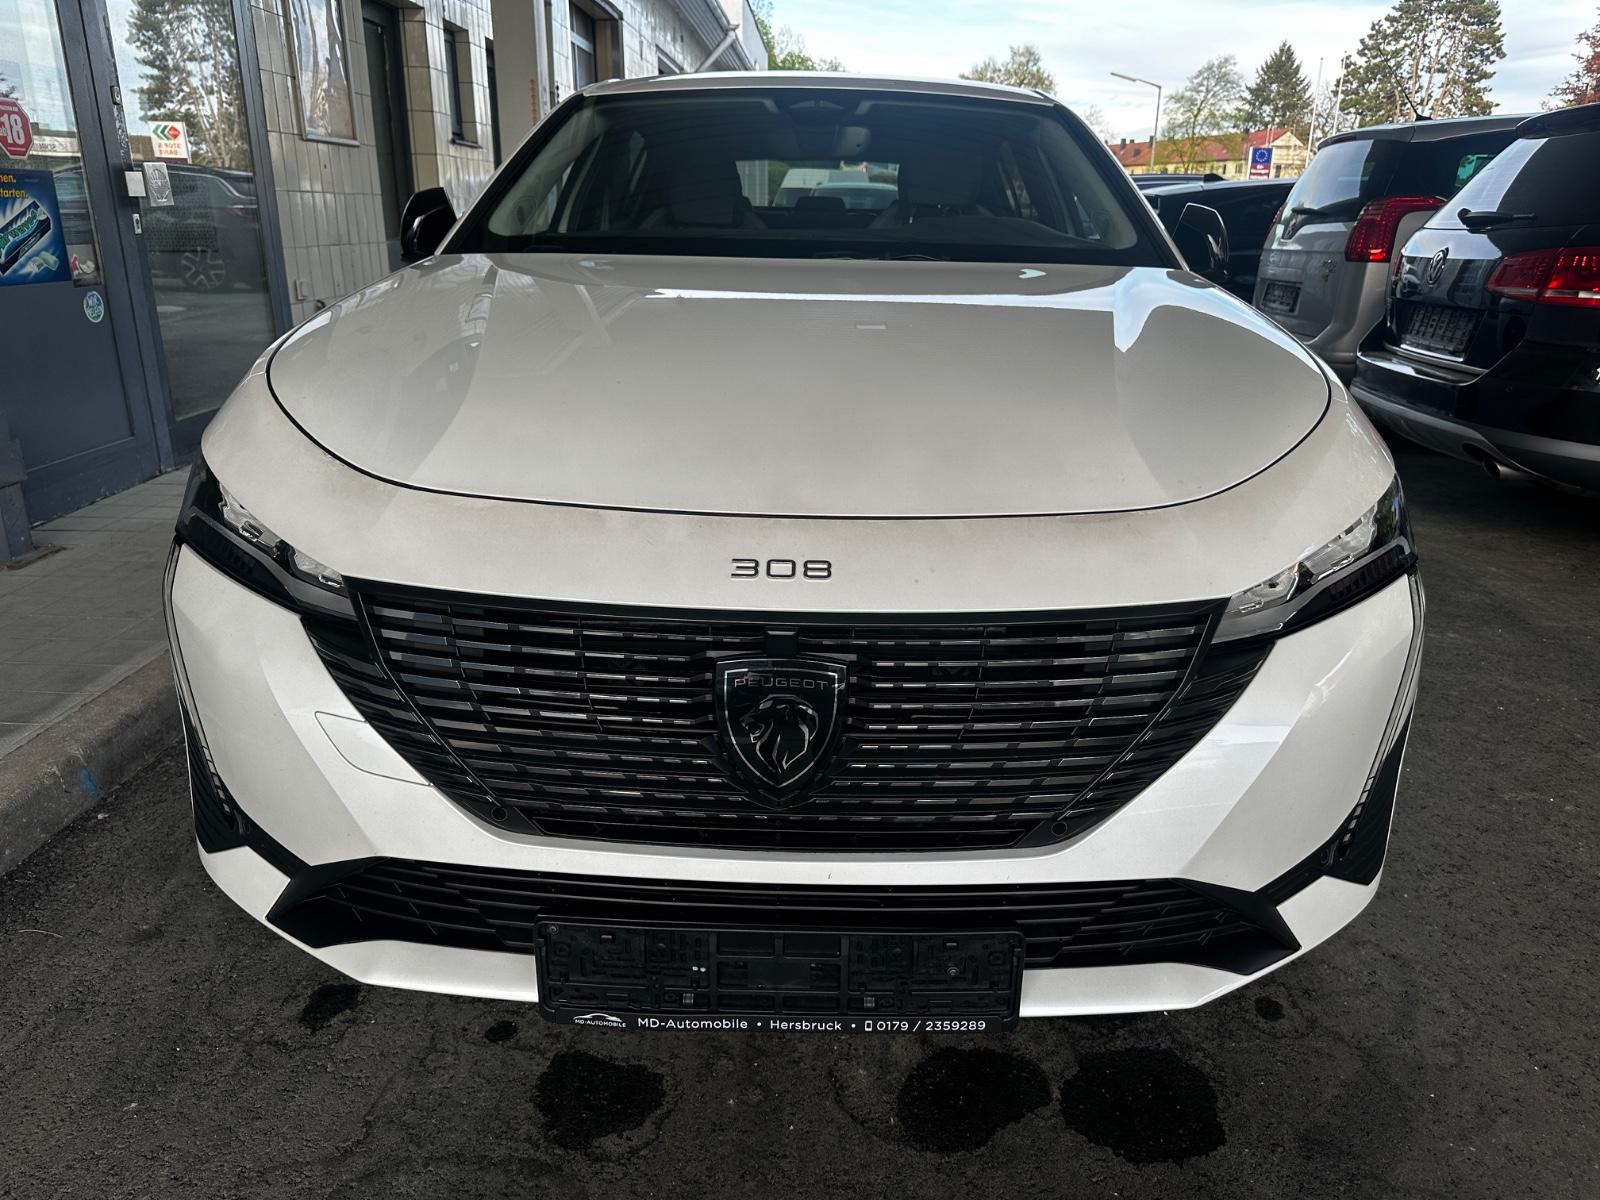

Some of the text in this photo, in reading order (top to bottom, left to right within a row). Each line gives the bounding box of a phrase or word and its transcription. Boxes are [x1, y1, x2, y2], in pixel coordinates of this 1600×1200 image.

[1, 113, 25, 145] 18
[731, 558, 832, 579] 308
[734, 677, 829, 690] PEUGEOT
[637, 1017, 748, 1029] MD-Automobile
[770, 1019, 842, 1031] Hersbruck
[876, 1020, 909, 1031] 0179
[925, 1020, 986, 1031] 2359289
